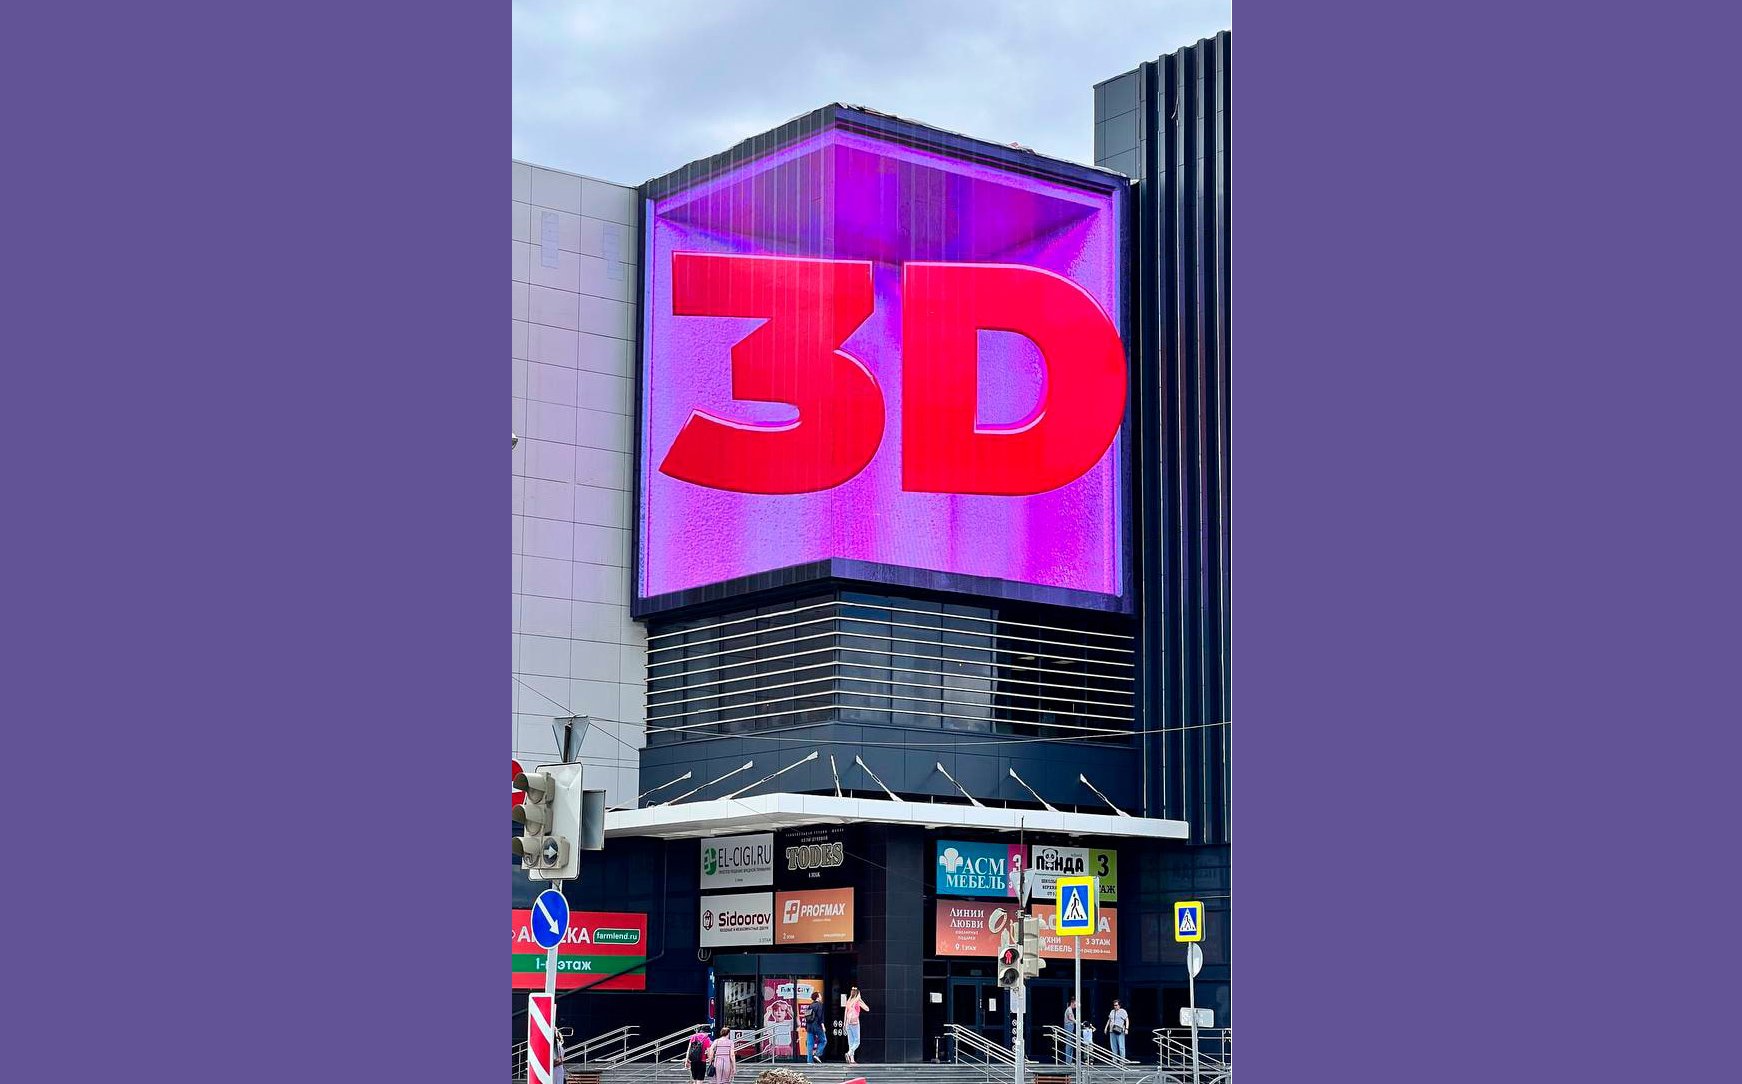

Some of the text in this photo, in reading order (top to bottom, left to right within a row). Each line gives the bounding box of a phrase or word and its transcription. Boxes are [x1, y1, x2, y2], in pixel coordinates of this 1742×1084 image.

[659, 250, 1128, 497] 3D
[785, 842, 844, 870] TODES
[962, 857, 1006, 876] АСМ
[1097, 854, 1110, 877] 3
[945, 874, 1006, 889] МЕБЕЛЬ
[800, 903, 846, 917] PROFMAX
[949, 908, 985, 918] ЛИНИИ
[718, 911, 771, 927] Sidoorov
[950, 918, 984, 928] ЛЮБВИ
[596, 932, 638, 940] farmlend.ru
[1090, 938, 1111, 946] ЭТАЖ
[557, 960, 592, 971] этаж
